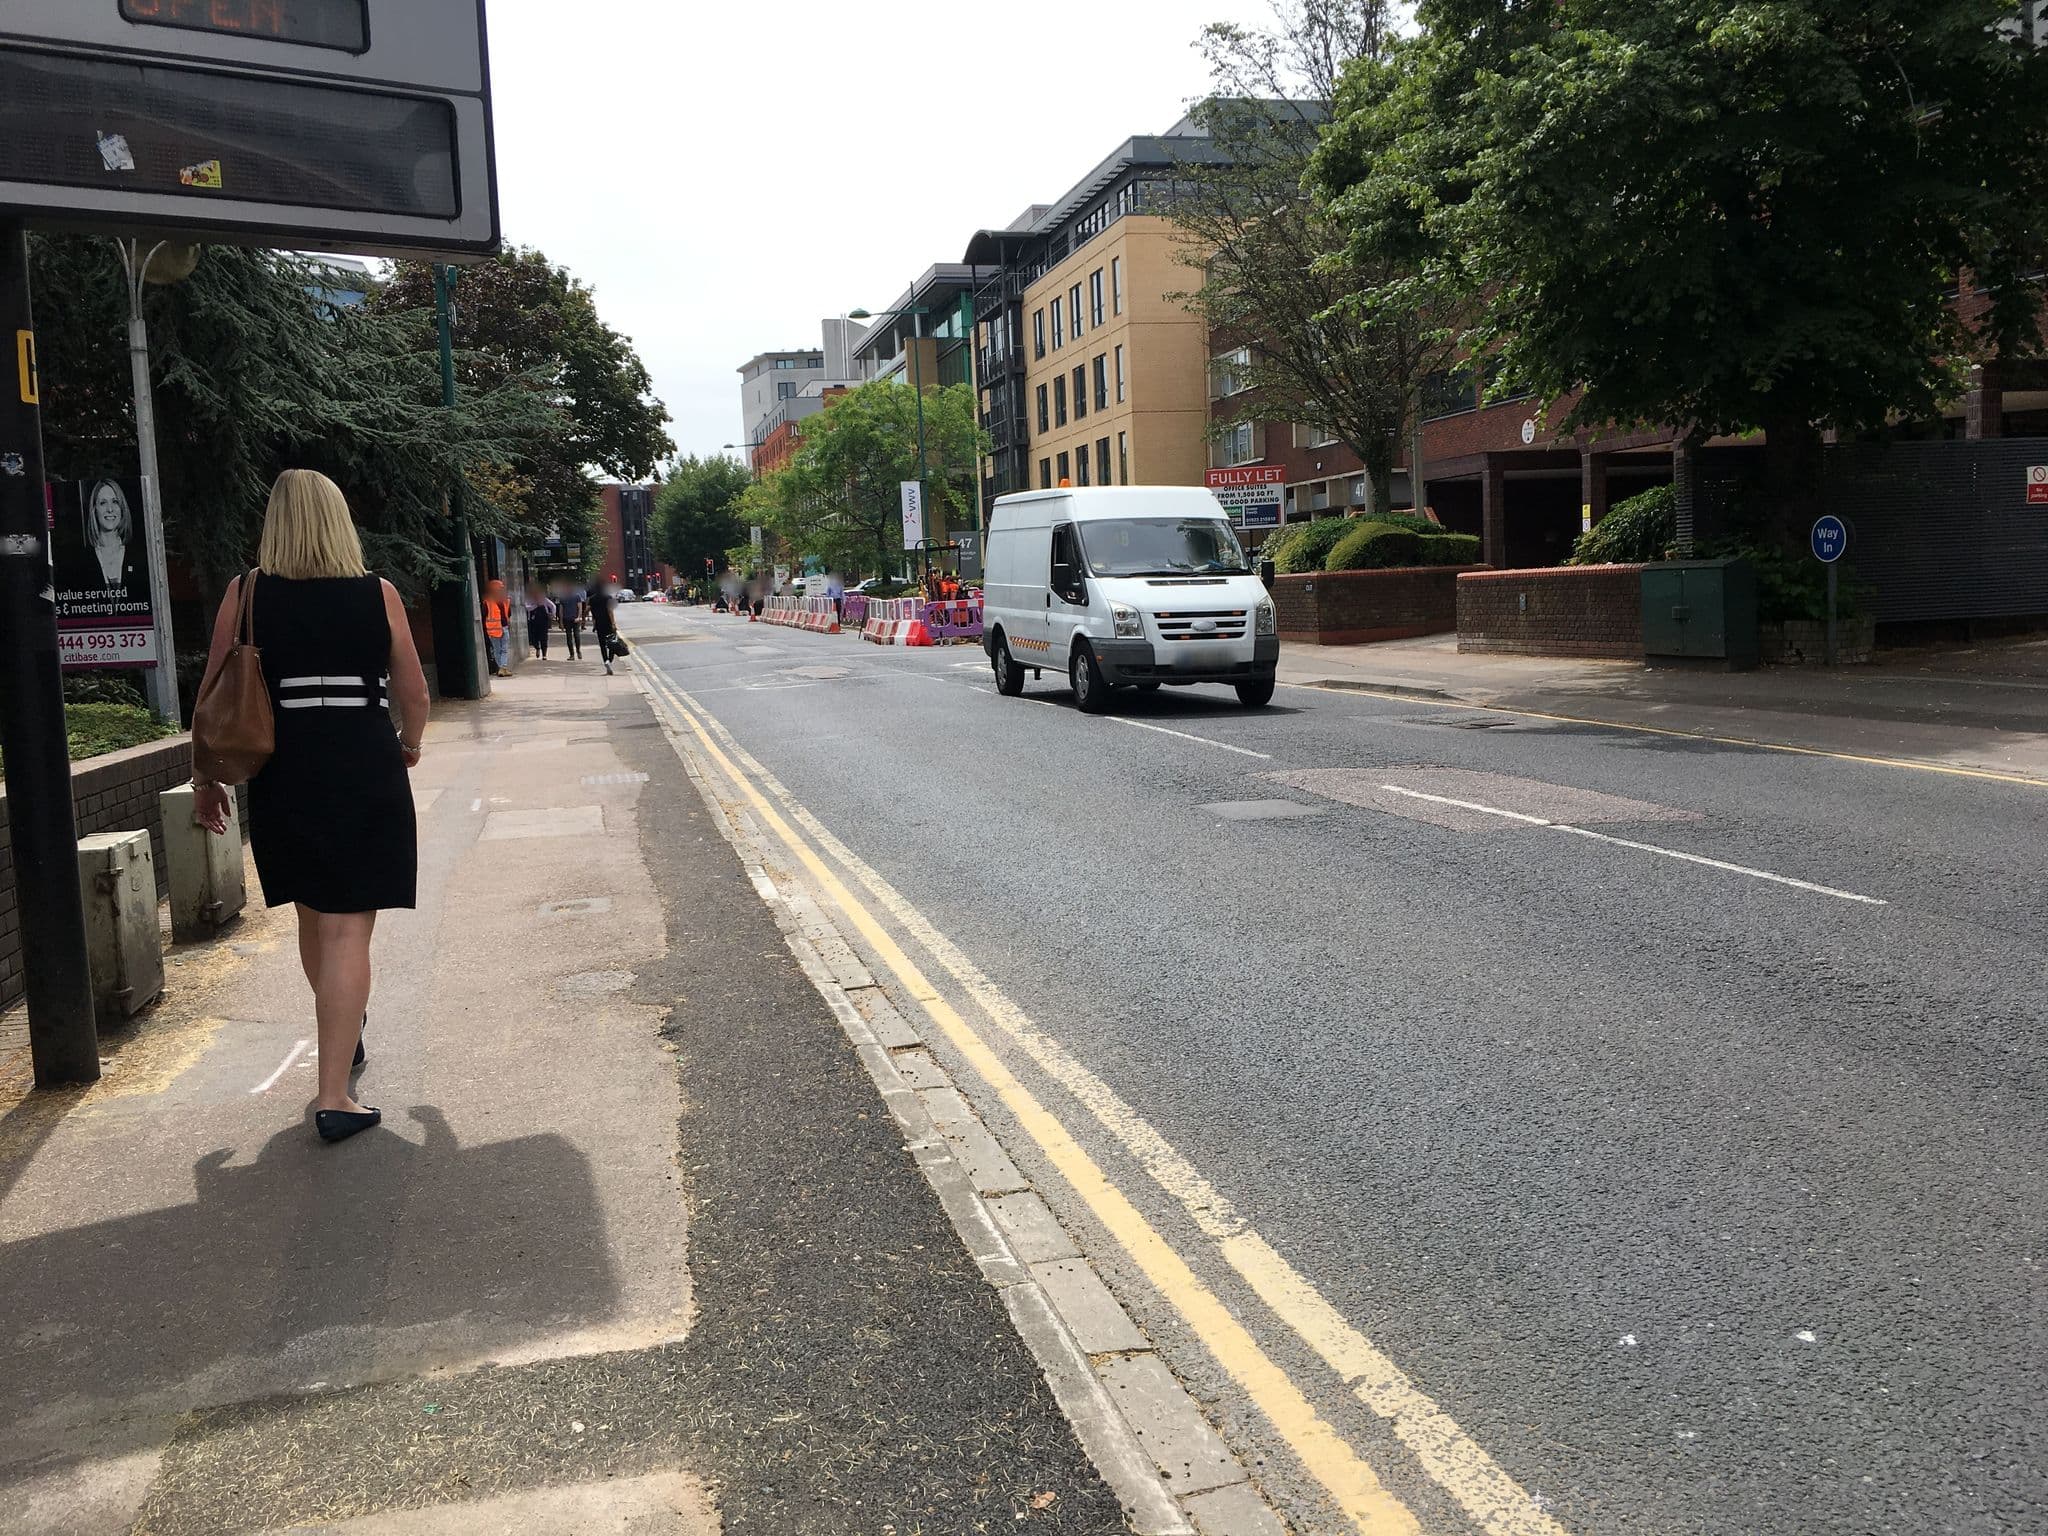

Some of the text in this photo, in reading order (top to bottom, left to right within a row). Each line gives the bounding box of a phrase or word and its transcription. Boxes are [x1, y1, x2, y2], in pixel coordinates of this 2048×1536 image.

[1210, 469, 1282, 484] FULLY LET
[1817, 528, 1839, 540] Way
[957, 538, 973, 549] 47
[1823, 542, 1833, 553] In
[56, 586, 128, 600] value serviced
[71, 602, 113, 615] meeting
[114, 601, 150, 612] rooms
[87, 635, 116, 649] 993
[119, 633, 147, 648] 373
